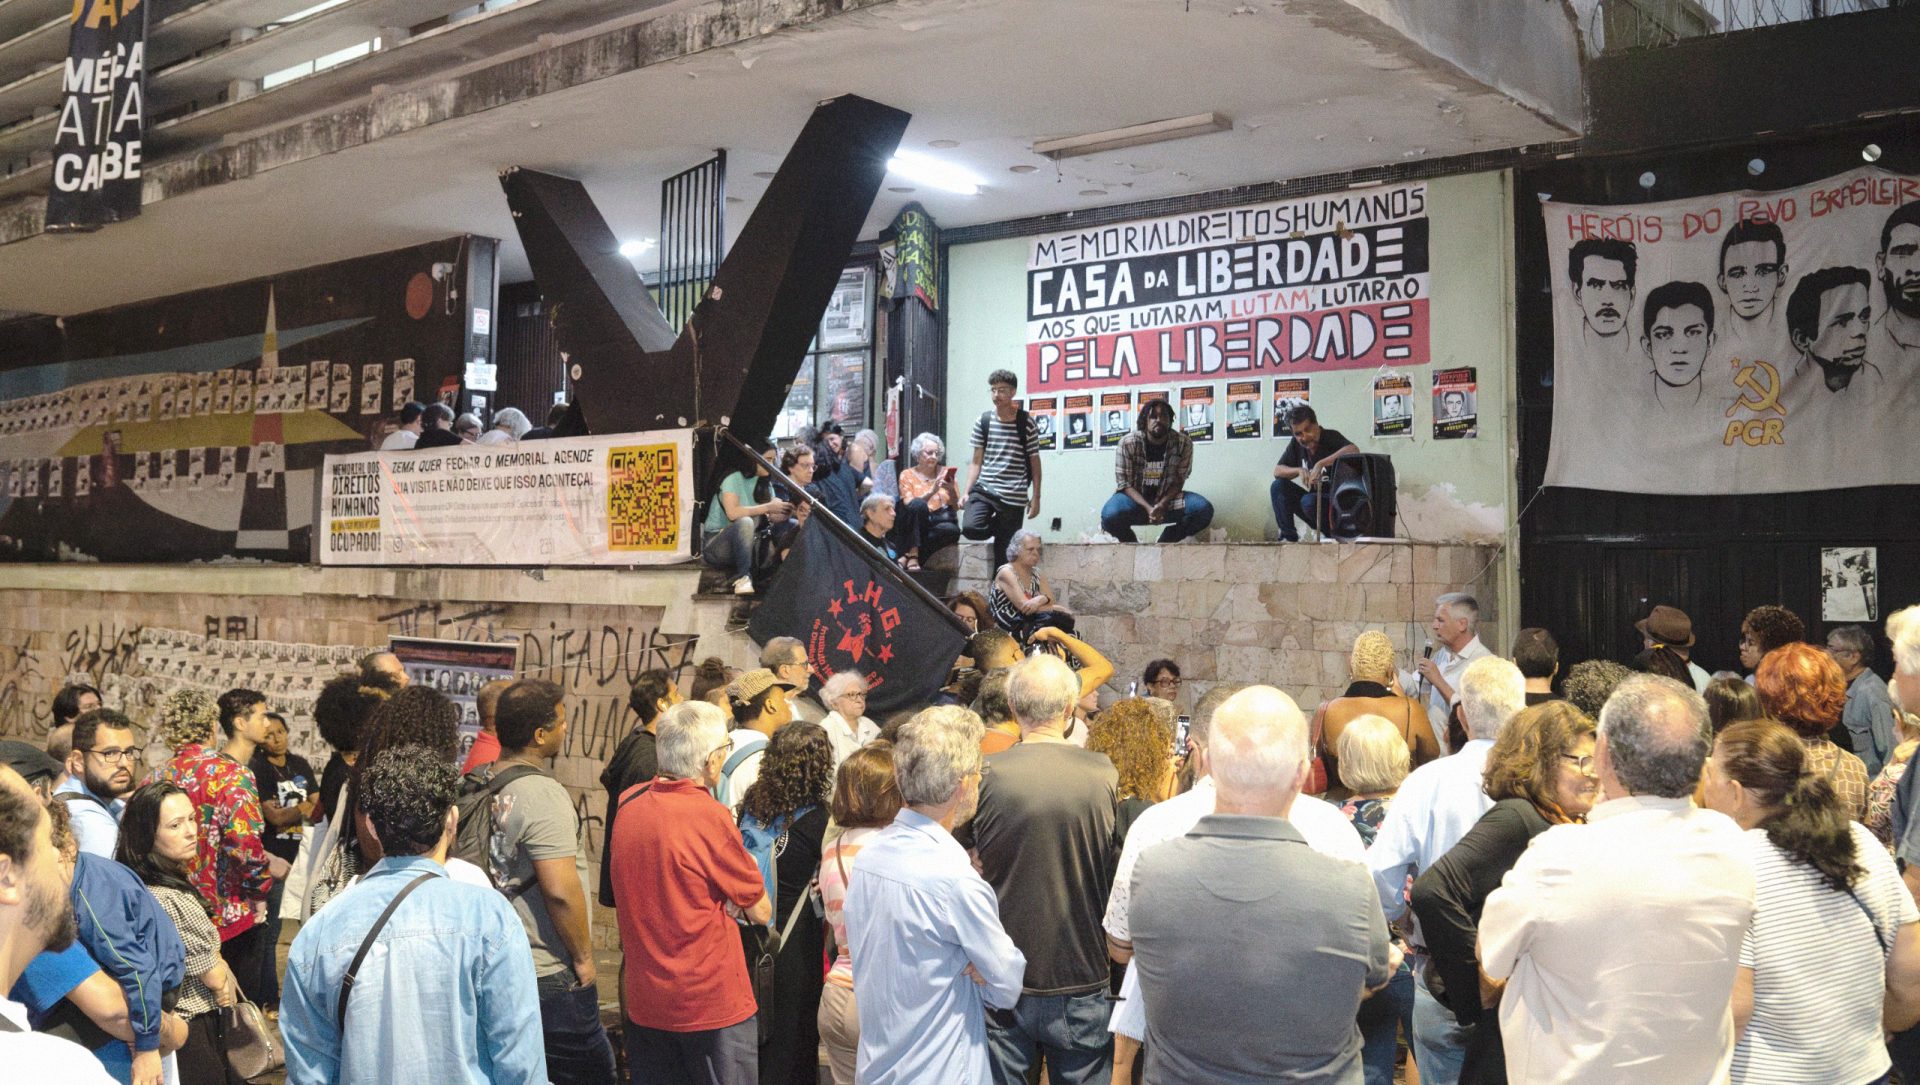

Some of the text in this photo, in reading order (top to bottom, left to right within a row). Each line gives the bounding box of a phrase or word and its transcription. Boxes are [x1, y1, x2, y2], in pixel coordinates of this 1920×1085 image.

[55, 141, 142, 192] CABE
[1683, 208, 1722, 239] DO
[1032, 227, 1403, 316] CASA DA LIBERDADE
[1039, 318, 1076, 339] AOS
[1084, 314, 1121, 335] QUE
[1131, 300, 1228, 329] LUTARAM,
[1231, 288, 1316, 317] LUTAM,
[1039, 304, 1413, 384] PELA LIBERDADE
[1723, 418, 1785, 446] PCR
[392, 461, 416, 474] ZEMA
[419, 459, 442, 472] QUER
[485, 455, 491, 468] O
[554, 449, 594, 464] AGENDE
[332, 474, 381, 495] DIREITOS
[410, 480, 437, 494] VISITA
[440, 480, 445, 492] E
[447, 475, 464, 491] NÃO
[467, 477, 492, 491] DEIXE
[494, 476, 512, 491] QUE
[514, 475, 537, 489] ISSO
[331, 496, 380, 517] HUMANOS
[330, 532, 382, 552] OCUPADO!
